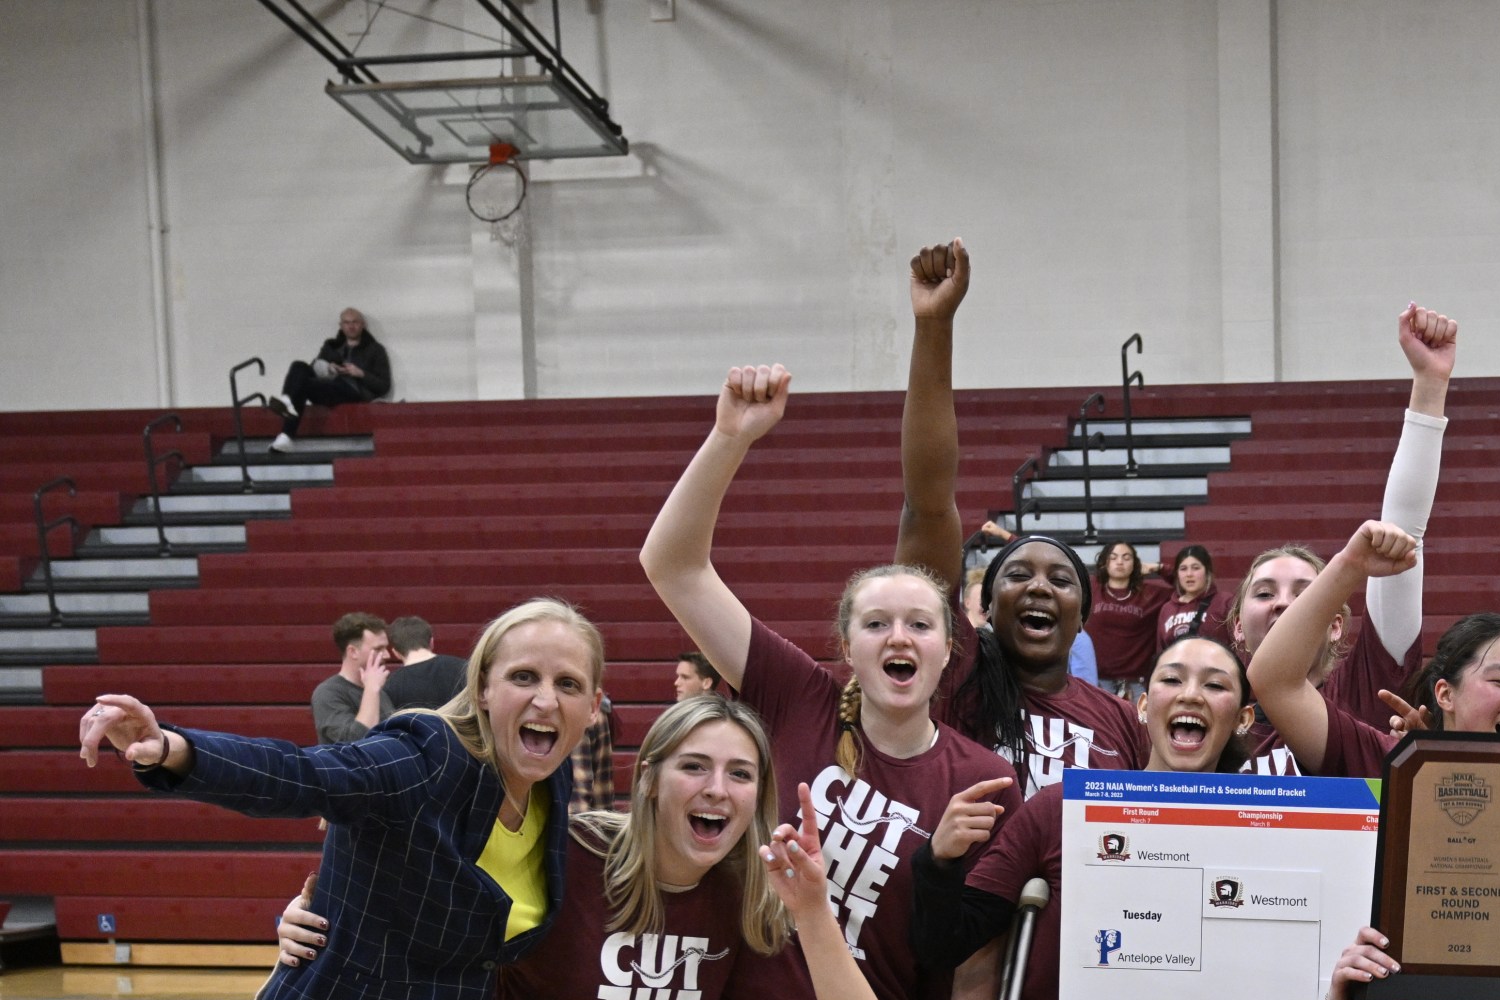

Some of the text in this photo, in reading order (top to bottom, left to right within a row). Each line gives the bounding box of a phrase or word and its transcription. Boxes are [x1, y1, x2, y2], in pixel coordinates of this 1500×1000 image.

[1019, 709, 1094, 769] UT
[1085, 781, 1306, 797] 2023 NAIA Women's Basketball First & Second Round Bracket
[1438, 787, 1488, 798] BASKETBALL
[810, 765, 920, 854] CUT
[1122, 808, 1159, 817] First Round
[1238, 811, 1283, 821] Championship
[1137, 851, 1190, 862] Westmont
[1416, 885, 1447, 896] FIRST
[1450, 886, 1458, 896] &
[1251, 894, 1307, 907] Westmont
[1441, 898, 1480, 908] ROUND
[1123, 909, 1162, 922] Tuesday
[1430, 910, 1489, 921] CHAMPION
[1448, 944, 1472, 953] 2023
[601, 932, 709, 990] CUT
[1117, 952, 1195, 966] Antelope Valley
